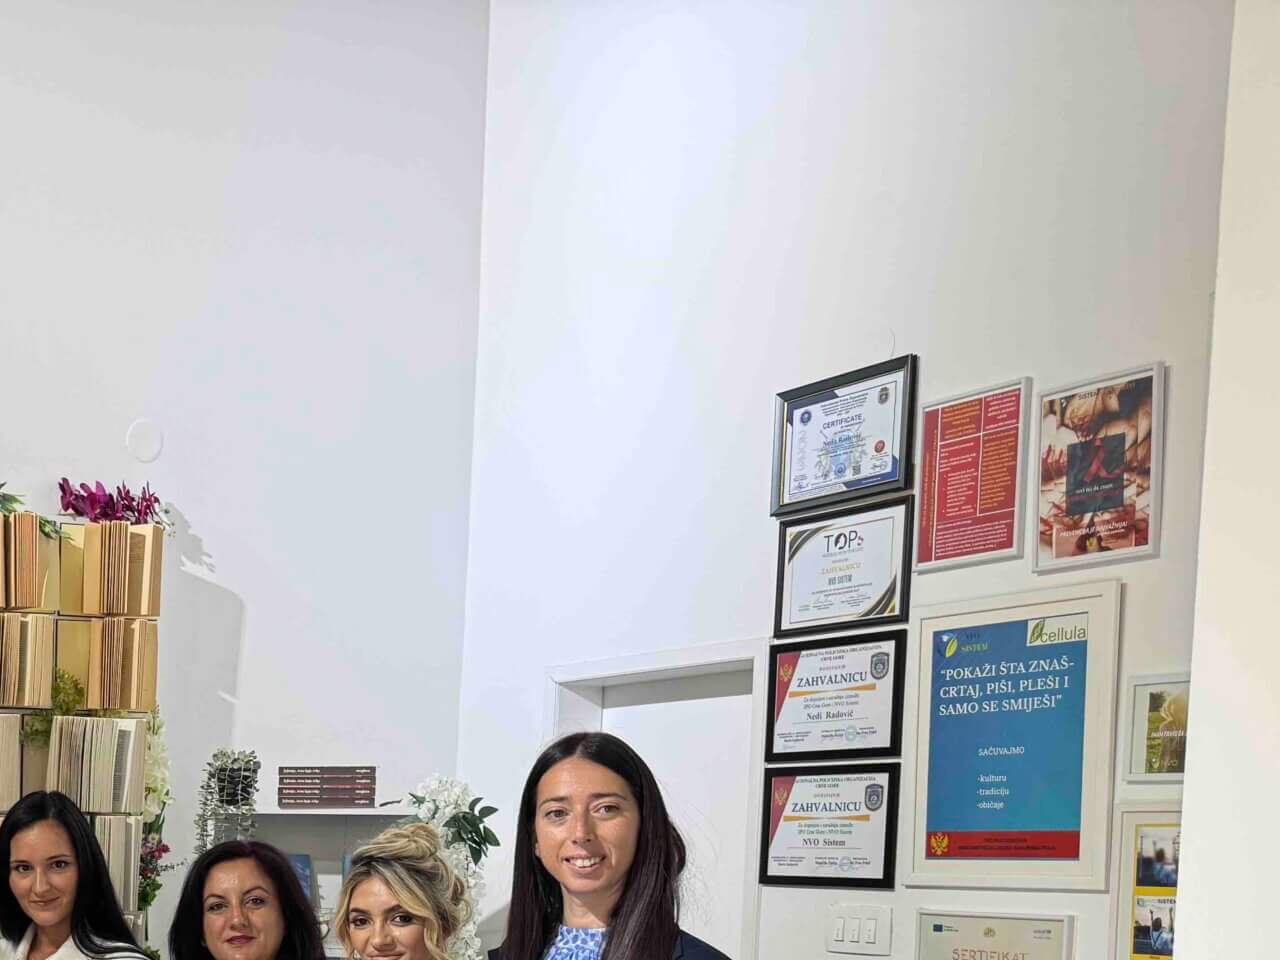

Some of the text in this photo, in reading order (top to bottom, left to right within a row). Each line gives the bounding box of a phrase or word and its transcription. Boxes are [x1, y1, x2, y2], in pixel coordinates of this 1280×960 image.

[822, 413, 862, 430] CERTIFICATE
[999, 661, 1026, 676] ŠTA
[1028, 656, 1075, 673] ZNAŠ-
[797, 671, 868, 688] ZAHVALNICU
[940, 685, 983, 698] CRTAJ,
[1019, 676, 1060, 690] PLEŠI
[1063, 676, 1070, 688] I
[939, 702, 979, 716] SAMO
[981, 700, 999, 712] SE
[978, 746, 1025, 756] SAČUVAJMO
[791, 801, 862, 813] ZAHVALNICU
[802, 838, 846, 847] NVO Sistem
